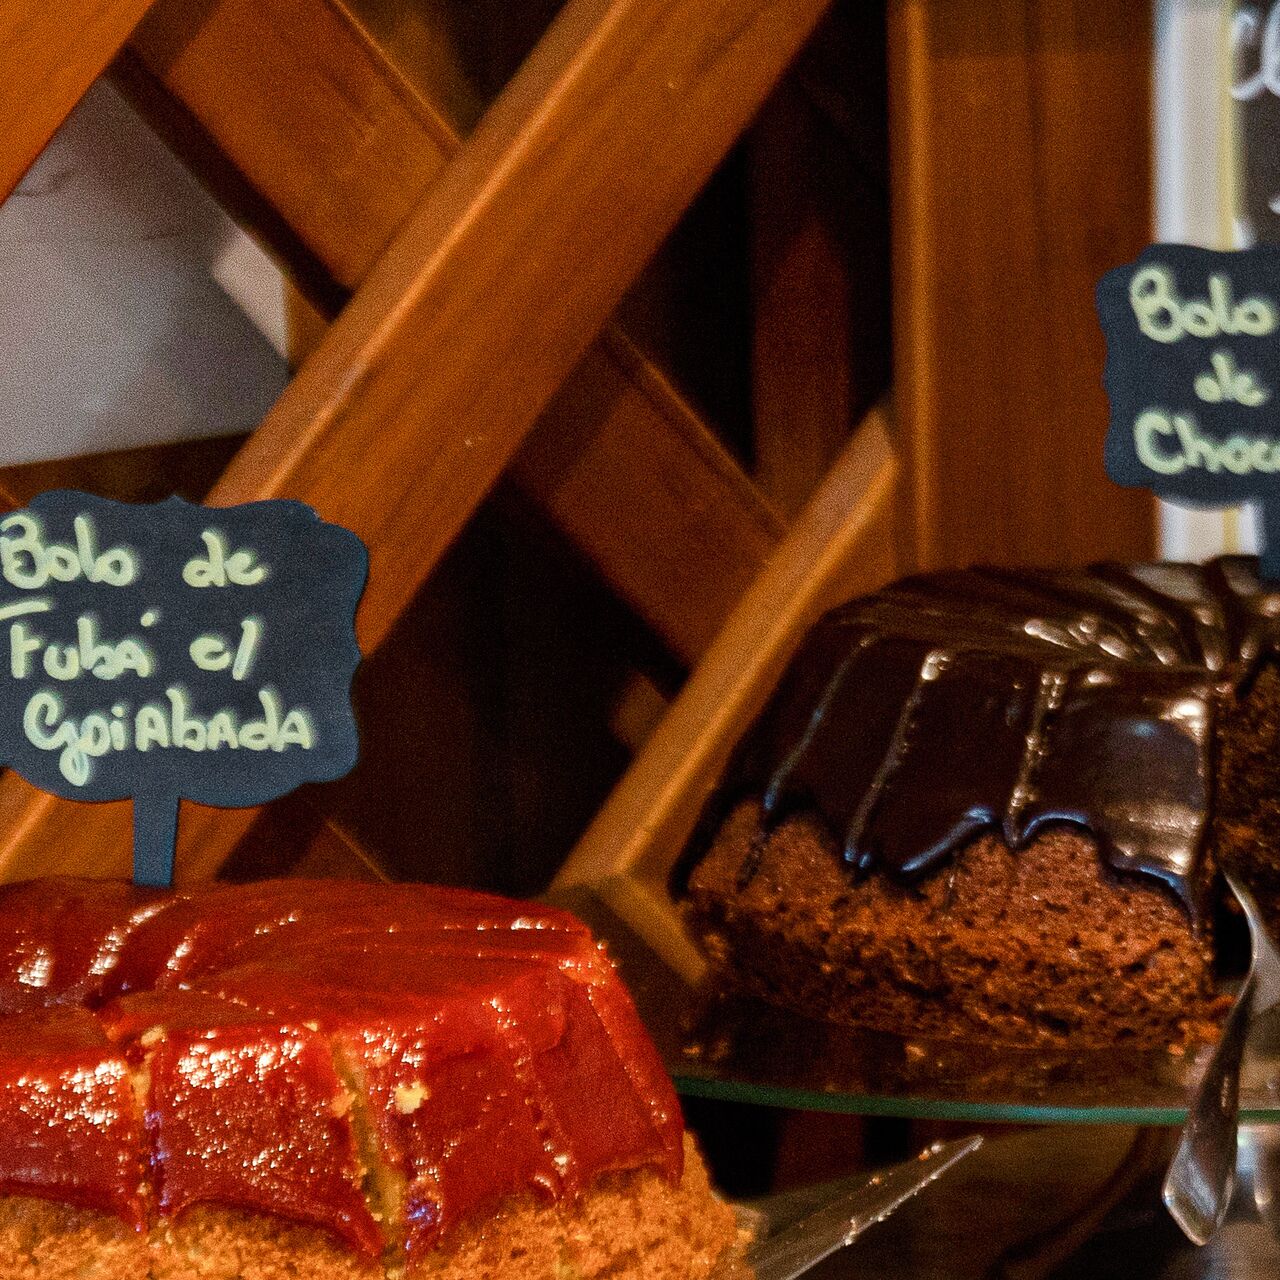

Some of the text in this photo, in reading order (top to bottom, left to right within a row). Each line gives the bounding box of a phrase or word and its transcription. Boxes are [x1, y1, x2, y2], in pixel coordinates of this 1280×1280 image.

[1129, 266, 1279, 344] Bolo
[1193, 352, 1268, 407] de
[0, 512, 270, 590] Bolo de
